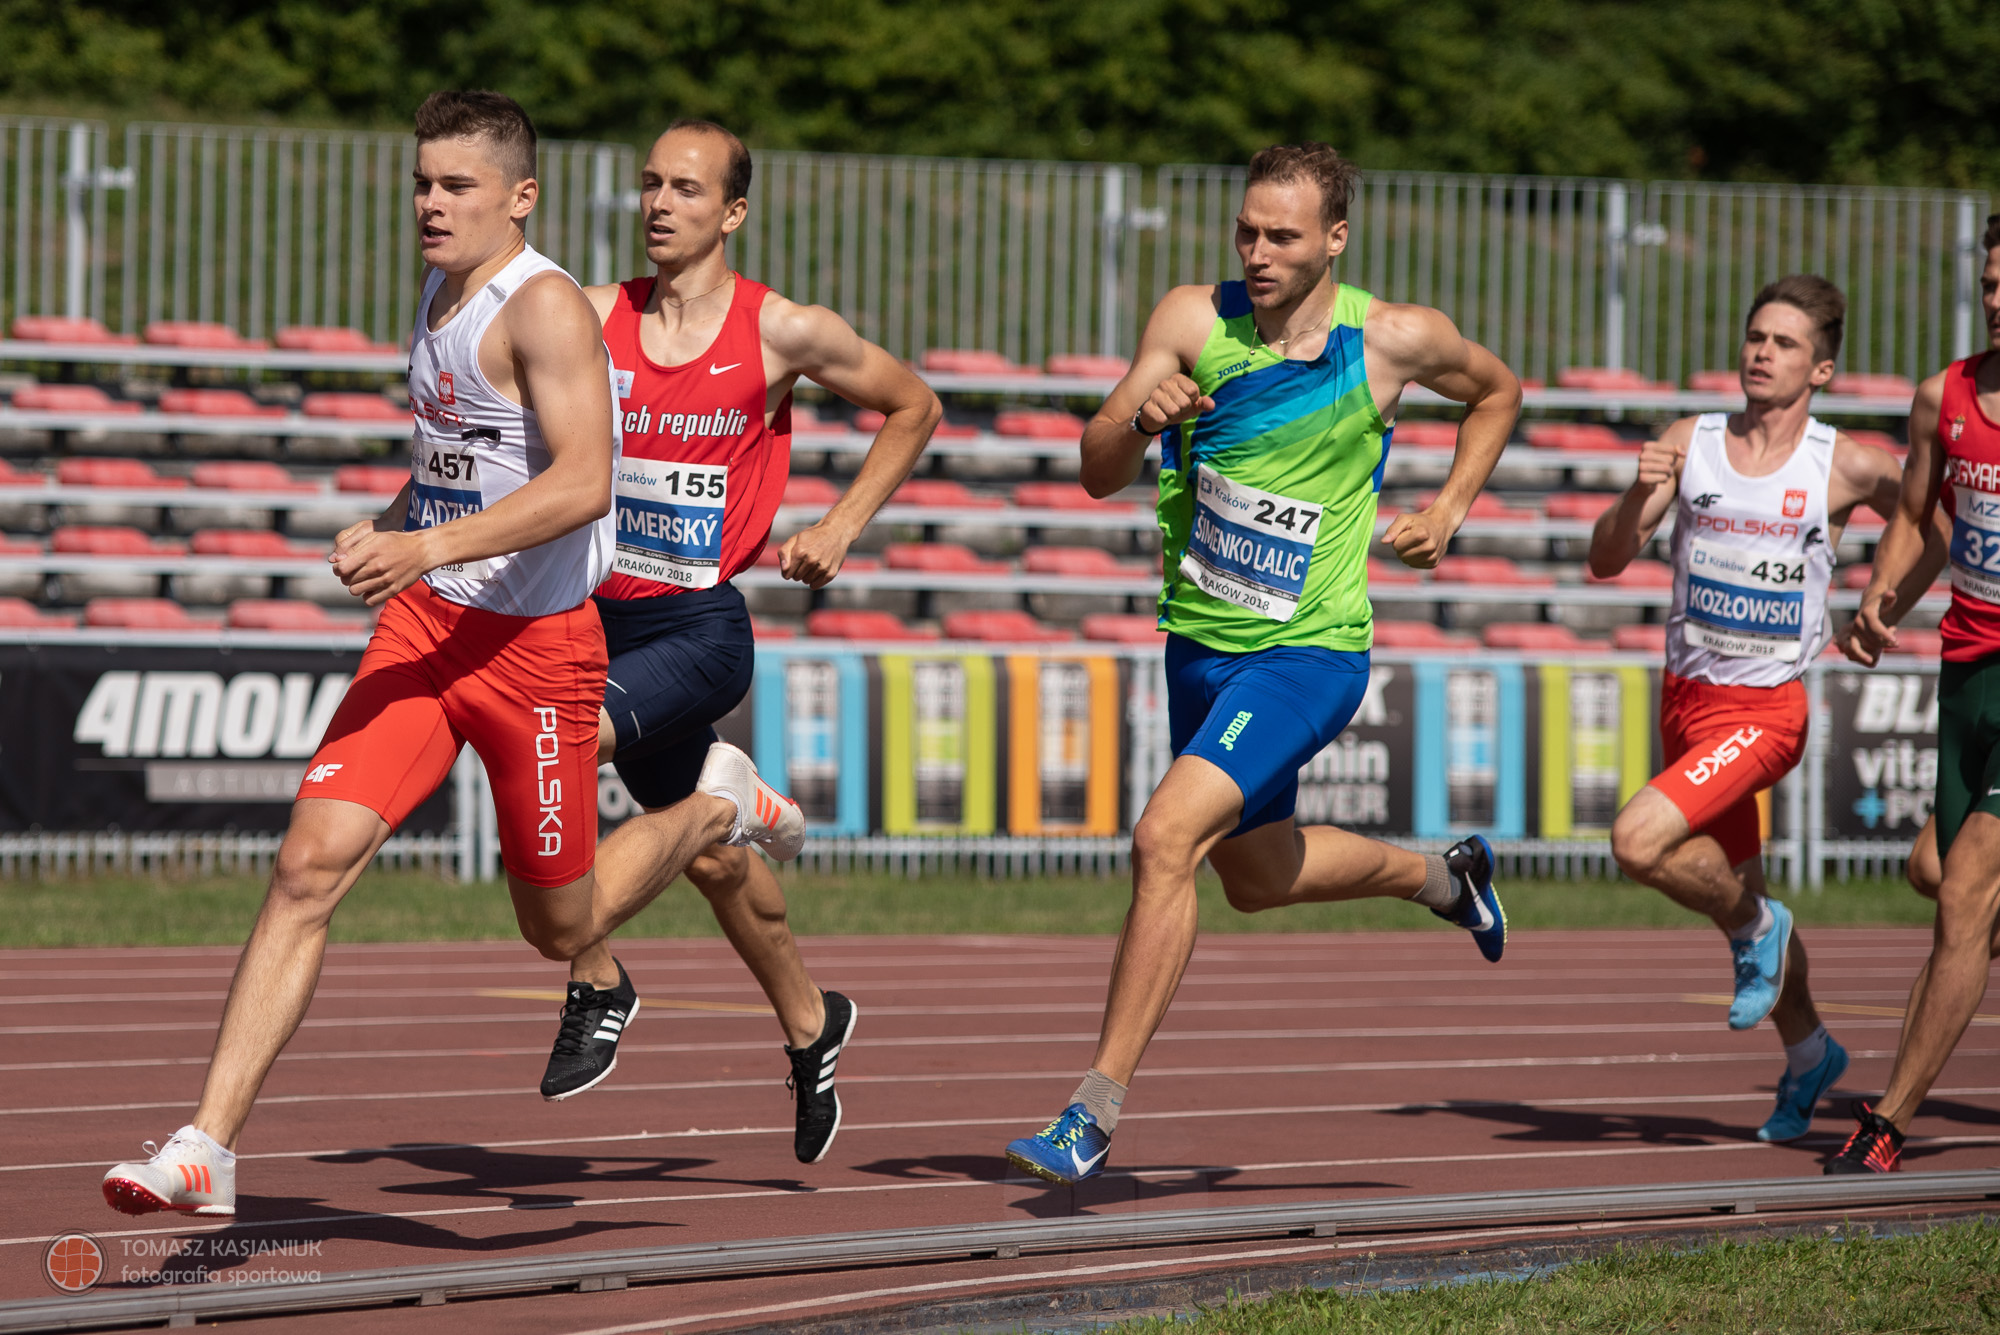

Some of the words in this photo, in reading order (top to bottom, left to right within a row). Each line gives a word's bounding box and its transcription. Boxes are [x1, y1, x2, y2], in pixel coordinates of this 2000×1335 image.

[657, 407, 748, 442] republic
[428, 451, 475, 481] 457
[665, 471, 725, 499] 155
[1215, 486, 1250, 511] Kraków
[1254, 499, 1320, 534] 247
[1697, 515, 1799, 539] POLSKA
[1195, 509, 1253, 565] ŠIMENKO
[1253, 544, 1305, 581] LALIC
[617, 557, 665, 576] KRAKÓW
[667, 568, 692, 583] 2018
[1709, 556, 1745, 573] Kraków
[1751, 560, 1806, 584] 434
[1199, 573, 1242, 600] KRAKÓW
[1243, 593, 1270, 611] 2018
[1690, 583, 1800, 626] KOZŁOWSKI
[1703, 635, 1747, 652] KRAKÓW
[1749, 645, 1775, 655] 2018
[305, 763, 343, 782] 4F
[533, 706, 562, 857] POLSKA
